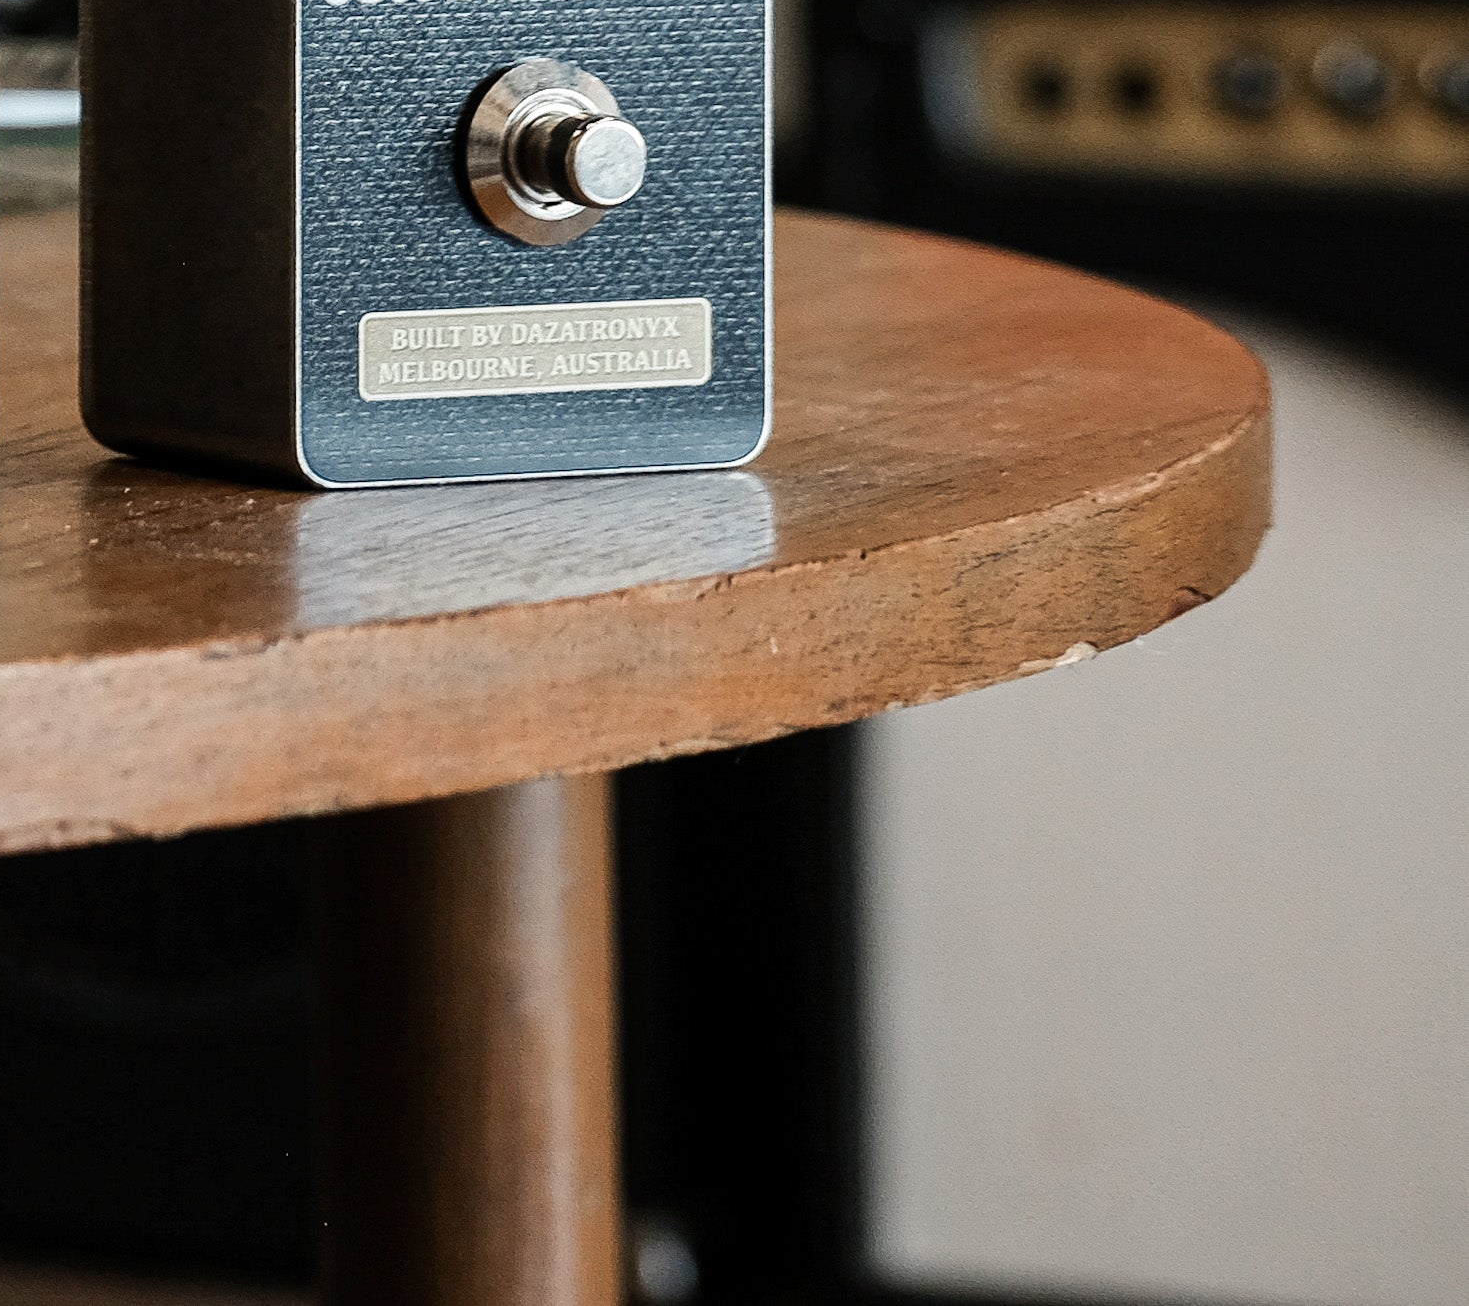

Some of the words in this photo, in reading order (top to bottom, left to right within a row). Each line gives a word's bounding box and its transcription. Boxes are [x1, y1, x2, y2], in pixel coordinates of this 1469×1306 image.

[391, 326, 466, 351] BUILT
[471, 325, 505, 346] BY
[510, 316, 682, 346] DAZATRONYX
[379, 355, 546, 385] MELBOURNE,
[550, 349, 692, 376] AUSTRALIA
